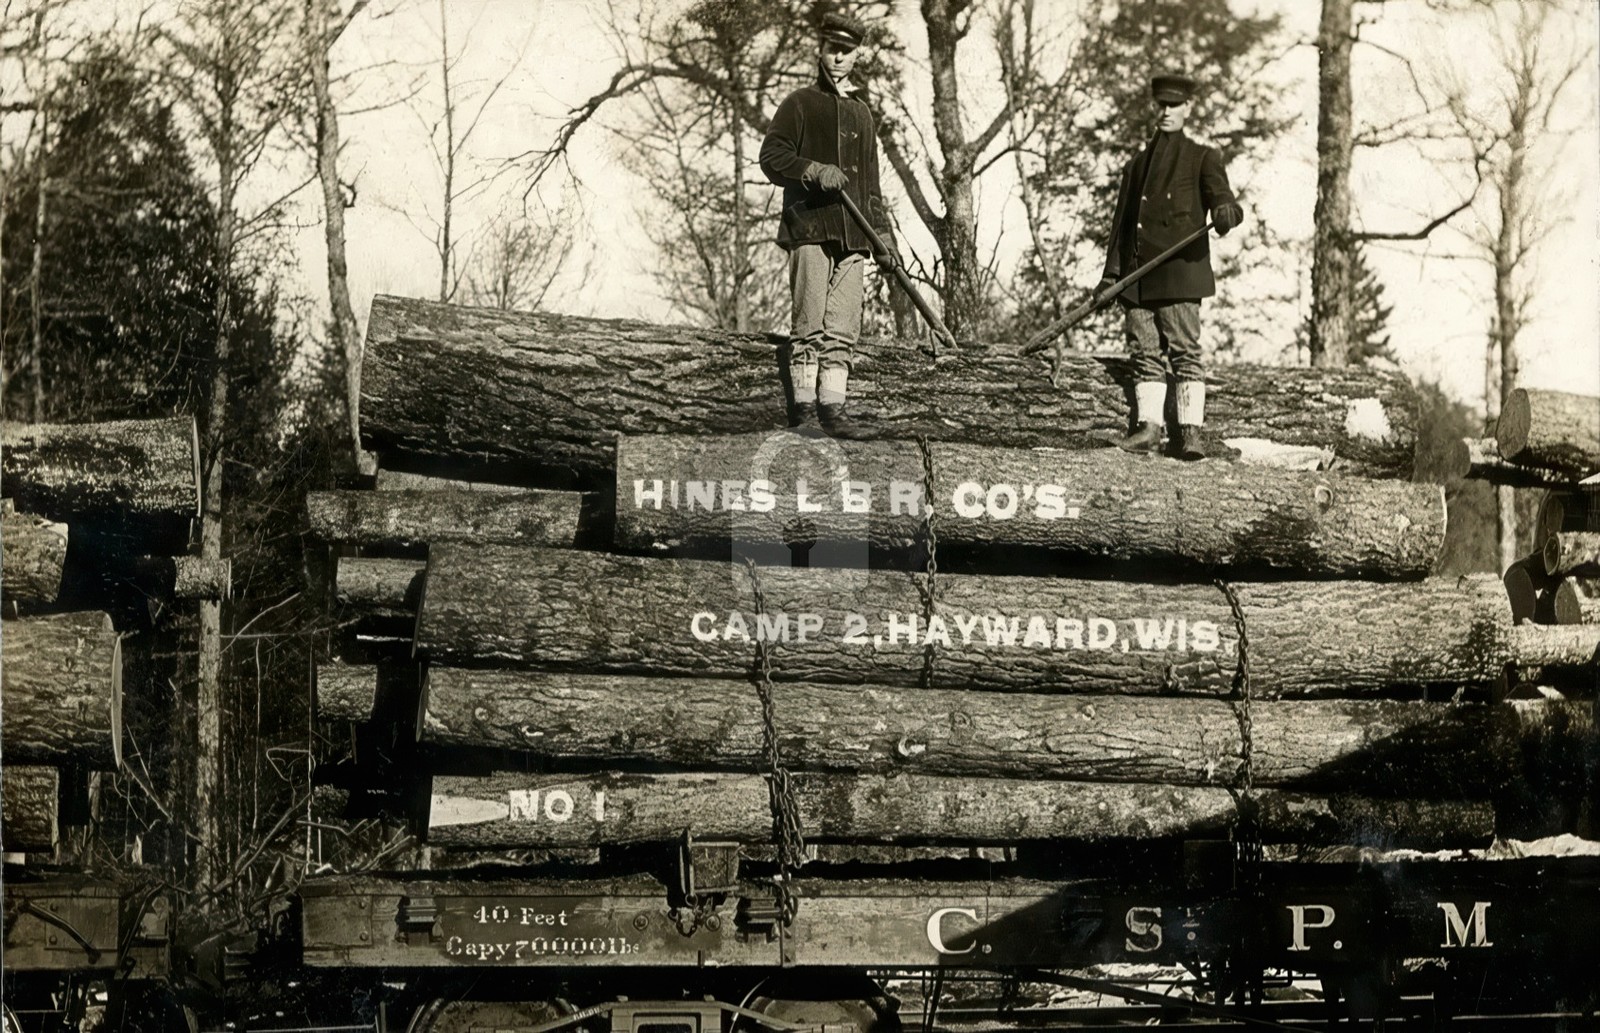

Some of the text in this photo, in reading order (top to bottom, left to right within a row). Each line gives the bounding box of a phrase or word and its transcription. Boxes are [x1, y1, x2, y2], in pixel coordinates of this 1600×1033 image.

[634, 479, 778, 512] HINES
[690, 611, 824, 643] CAMP
[508, 790, 575, 822] NO
[473, 906, 568, 926] 40 Feet
[1286, 904, 1343, 952] P.
[1437, 901, 1494, 948] M
[446, 936, 511, 961] Capy
